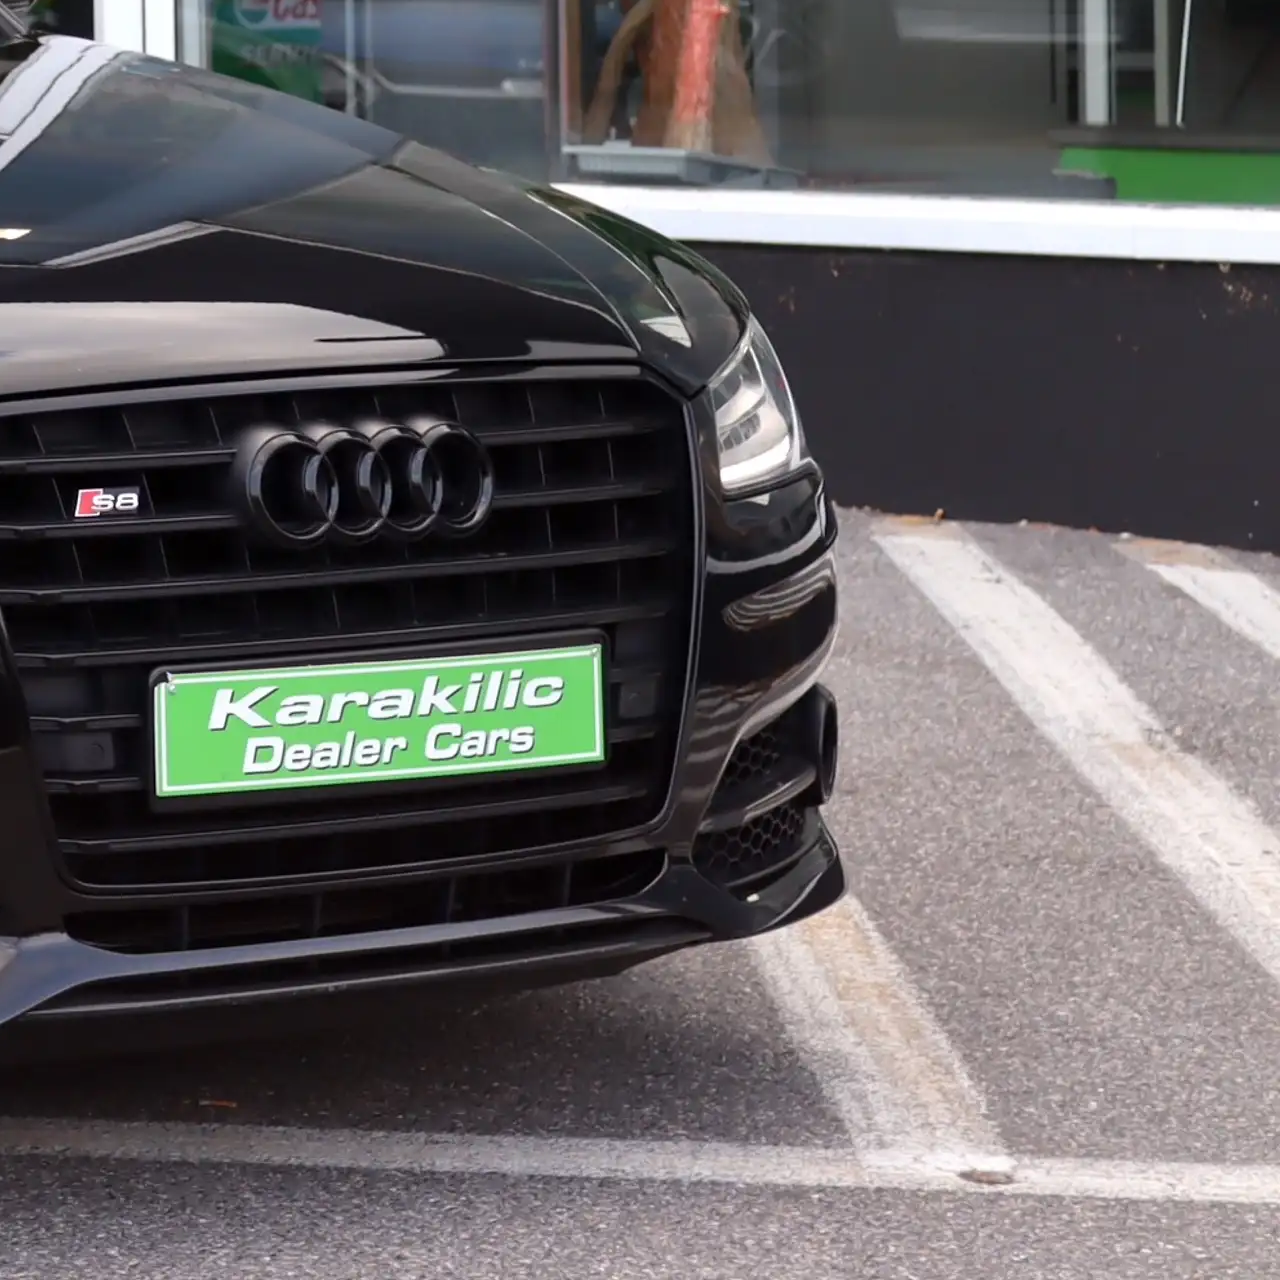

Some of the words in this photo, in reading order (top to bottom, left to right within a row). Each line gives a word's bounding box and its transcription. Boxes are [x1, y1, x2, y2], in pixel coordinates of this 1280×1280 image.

[91, 492, 139, 512] S8
[207, 668, 565, 732] Karakilic
[242, 730, 408, 775] Dealer
[424, 723, 535, 761] Cars
